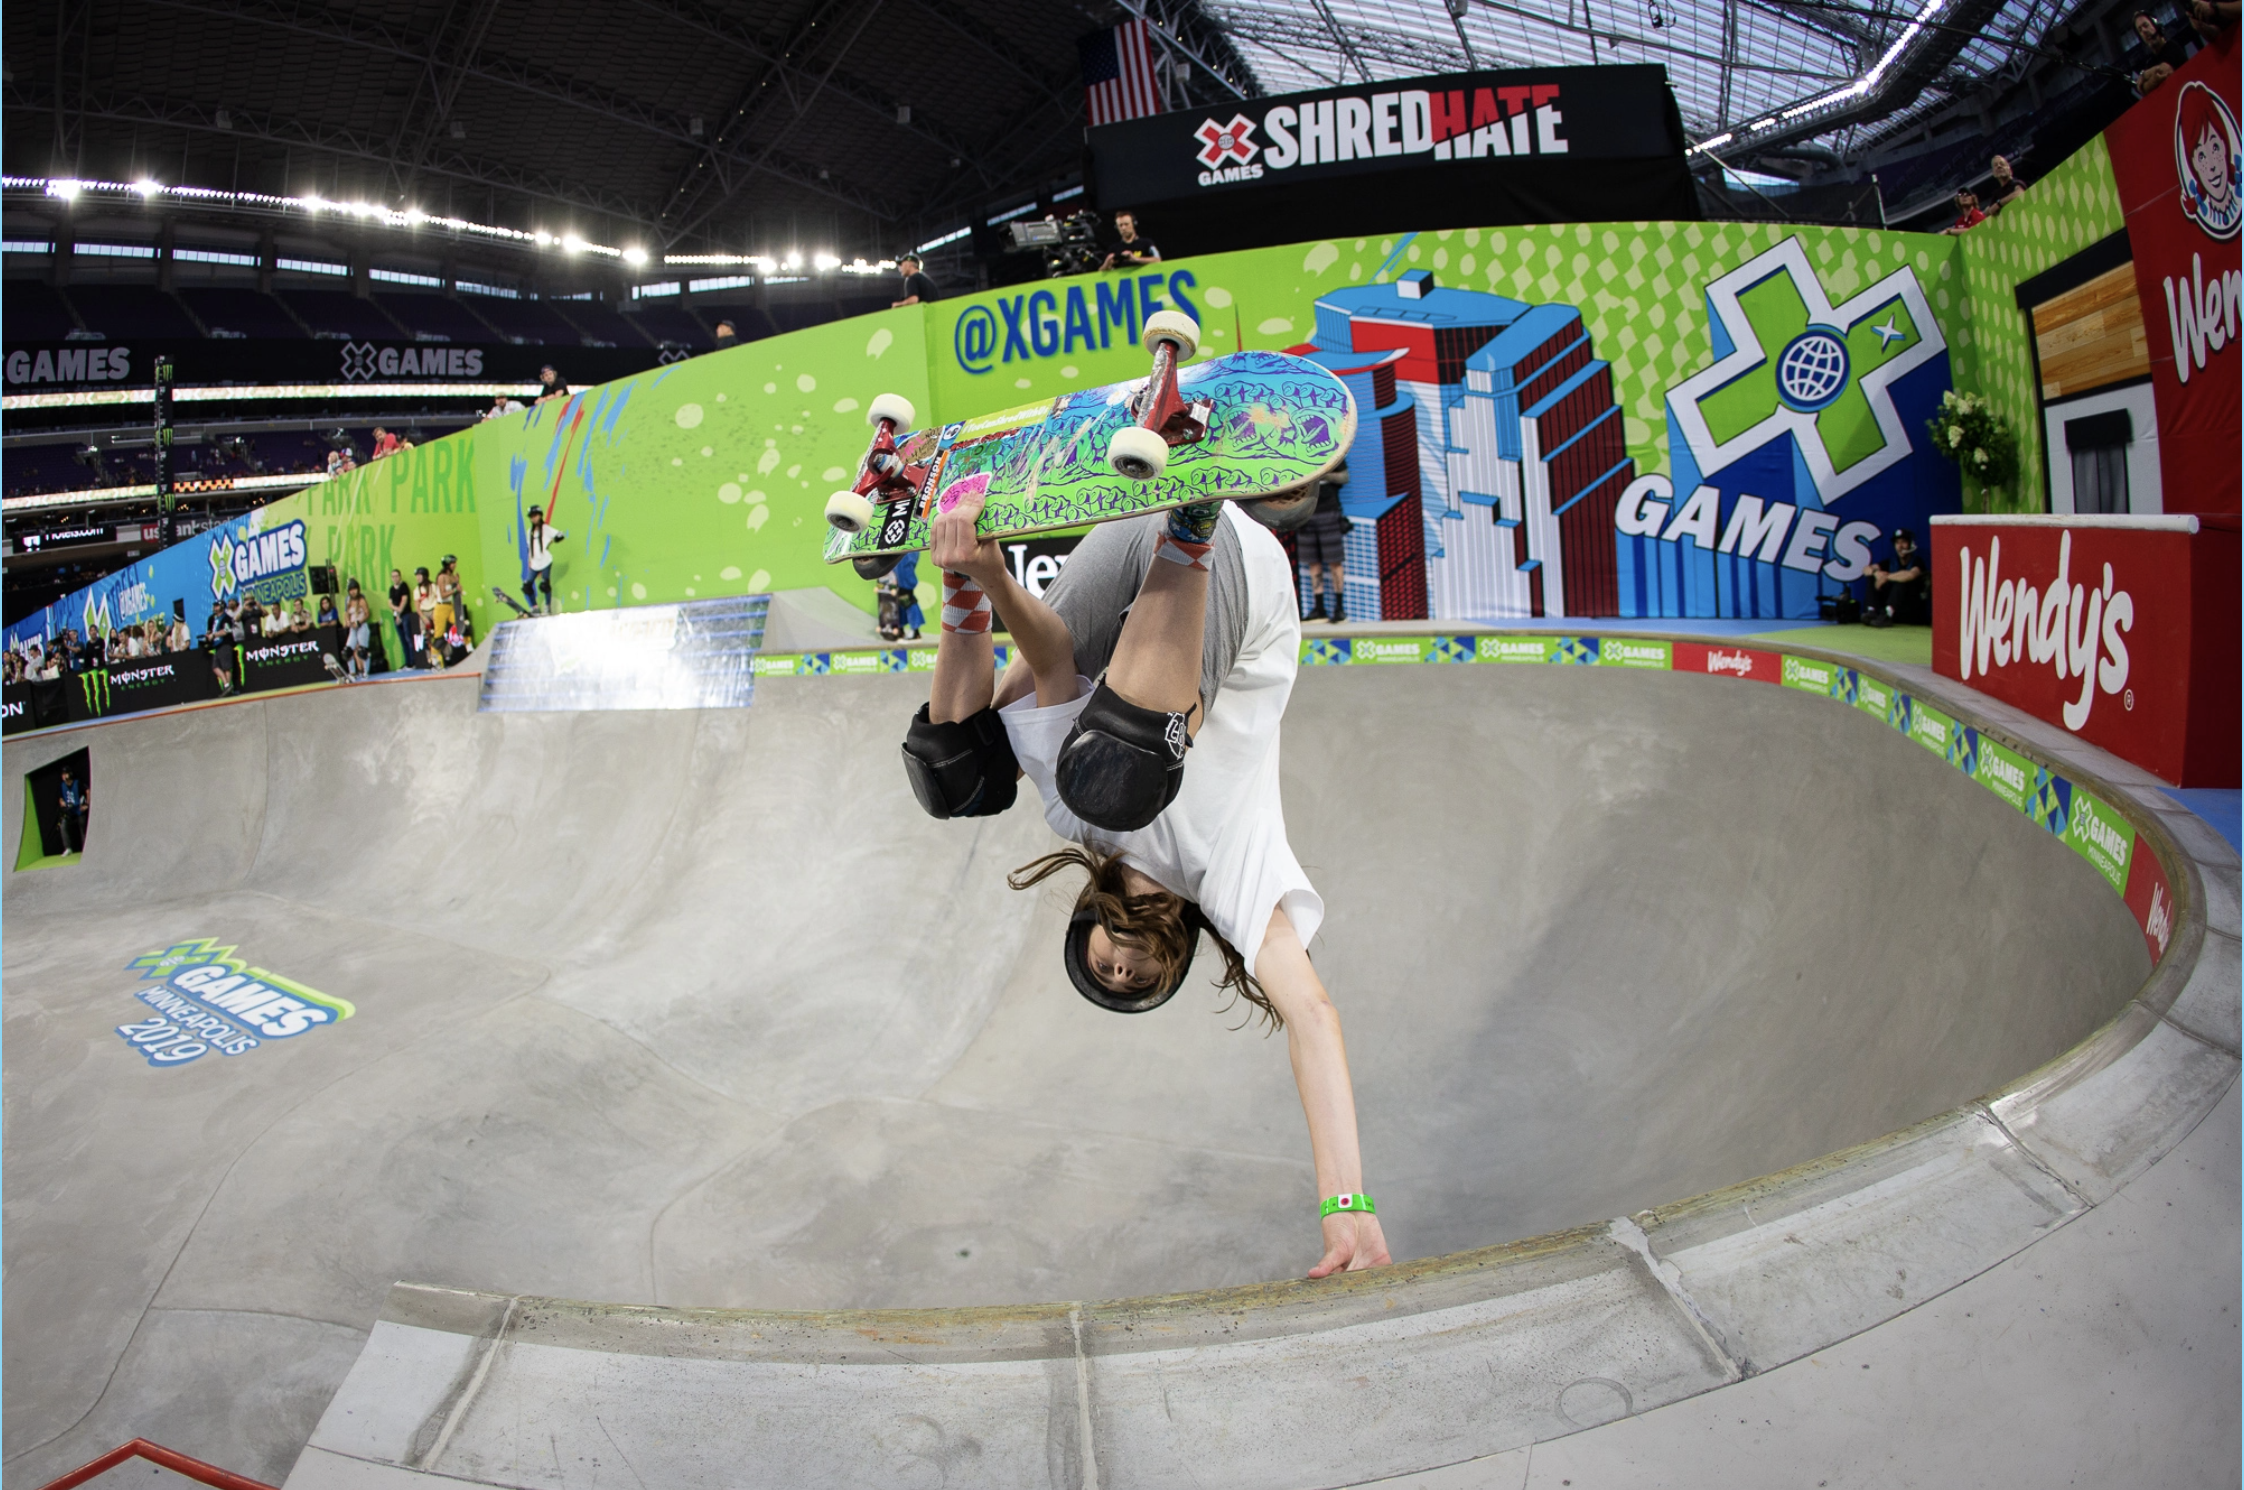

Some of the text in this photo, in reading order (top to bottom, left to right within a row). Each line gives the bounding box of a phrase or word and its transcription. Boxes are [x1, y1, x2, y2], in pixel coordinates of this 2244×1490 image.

[1198, 164, 1264, 186] GAMES
[954, 269, 1201, 375] @XGAMES
[6, 347, 131, 385] GAMES
[378, 347, 484, 377] GAMES
[391, 439, 476, 514] PARK
[1614, 474, 1881, 582] GAMES
[234, 523, 305, 583] GAMES
[1376, 643, 1420, 655] GAMES
[1501, 643, 1545, 655] GAMES
[1960, 529, 2133, 731] Wendy's
[1624, 646, 1665, 659] GAMES
[1708, 650, 1752, 676] Wendy's
[1799, 666, 1829, 684] GAMES
[1993, 756, 2025, 792] GAMES
[2091, 816, 2127, 866] GAMES
[2088, 844, 2121, 885] MINNEAPOLIS
[136, 984, 258, 1056] MINNEAPOLIS
[173, 966, 329, 1036] GAMES
[116, 1016, 209, 1062] 2019
